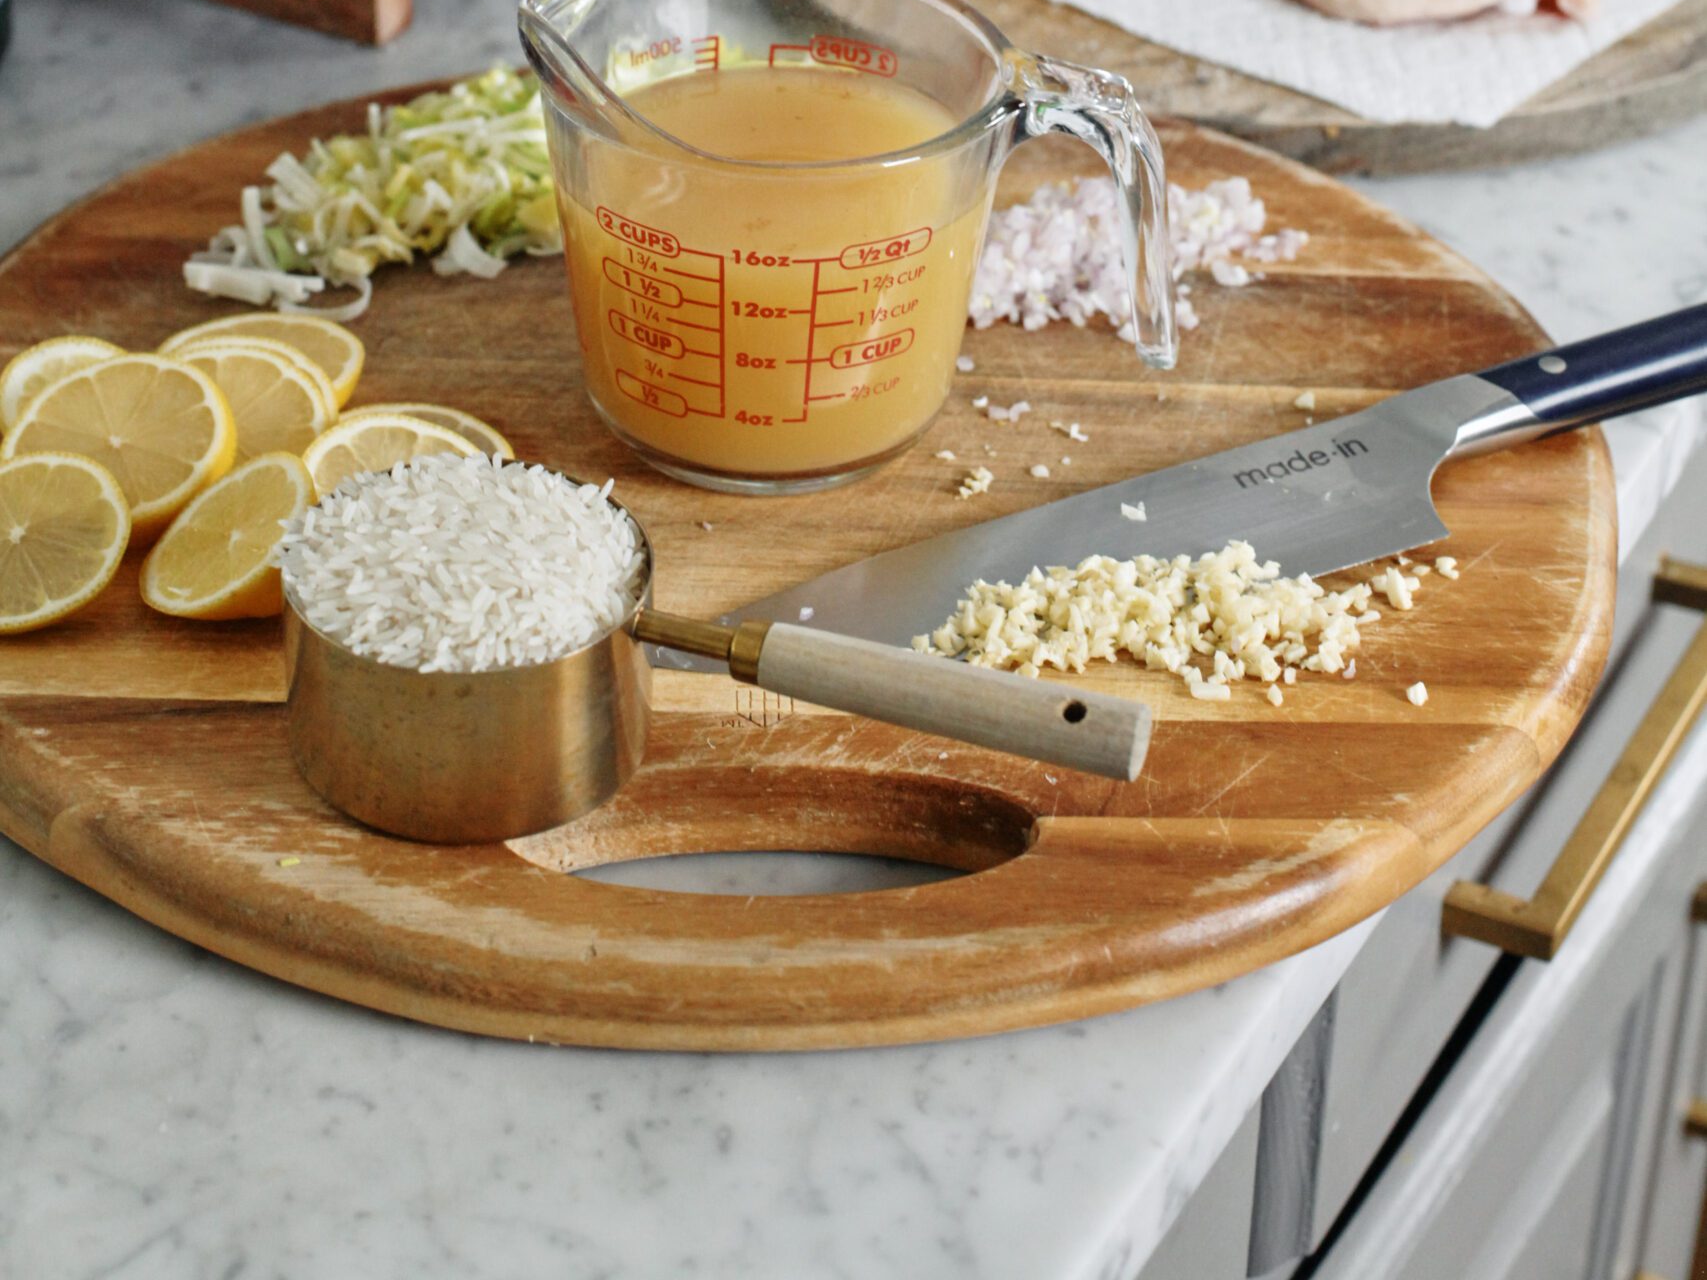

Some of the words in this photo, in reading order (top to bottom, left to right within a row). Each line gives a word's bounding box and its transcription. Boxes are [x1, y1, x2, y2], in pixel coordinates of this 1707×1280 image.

[603, 213, 613, 230] 2
[619, 222, 675, 253] CUPS
[885, 239, 911, 257] Qt
[732, 249, 790, 267] 16oz
[897, 265, 926, 285] CUP
[731, 301, 787, 319] 12oz
[891, 299, 919, 318] CUP
[634, 325, 672, 351] CUP
[862, 337, 902, 360] CUP
[735, 352, 777, 369] 8oz
[873, 376, 900, 397] CUP
[734, 410, 774, 426] 4oz
